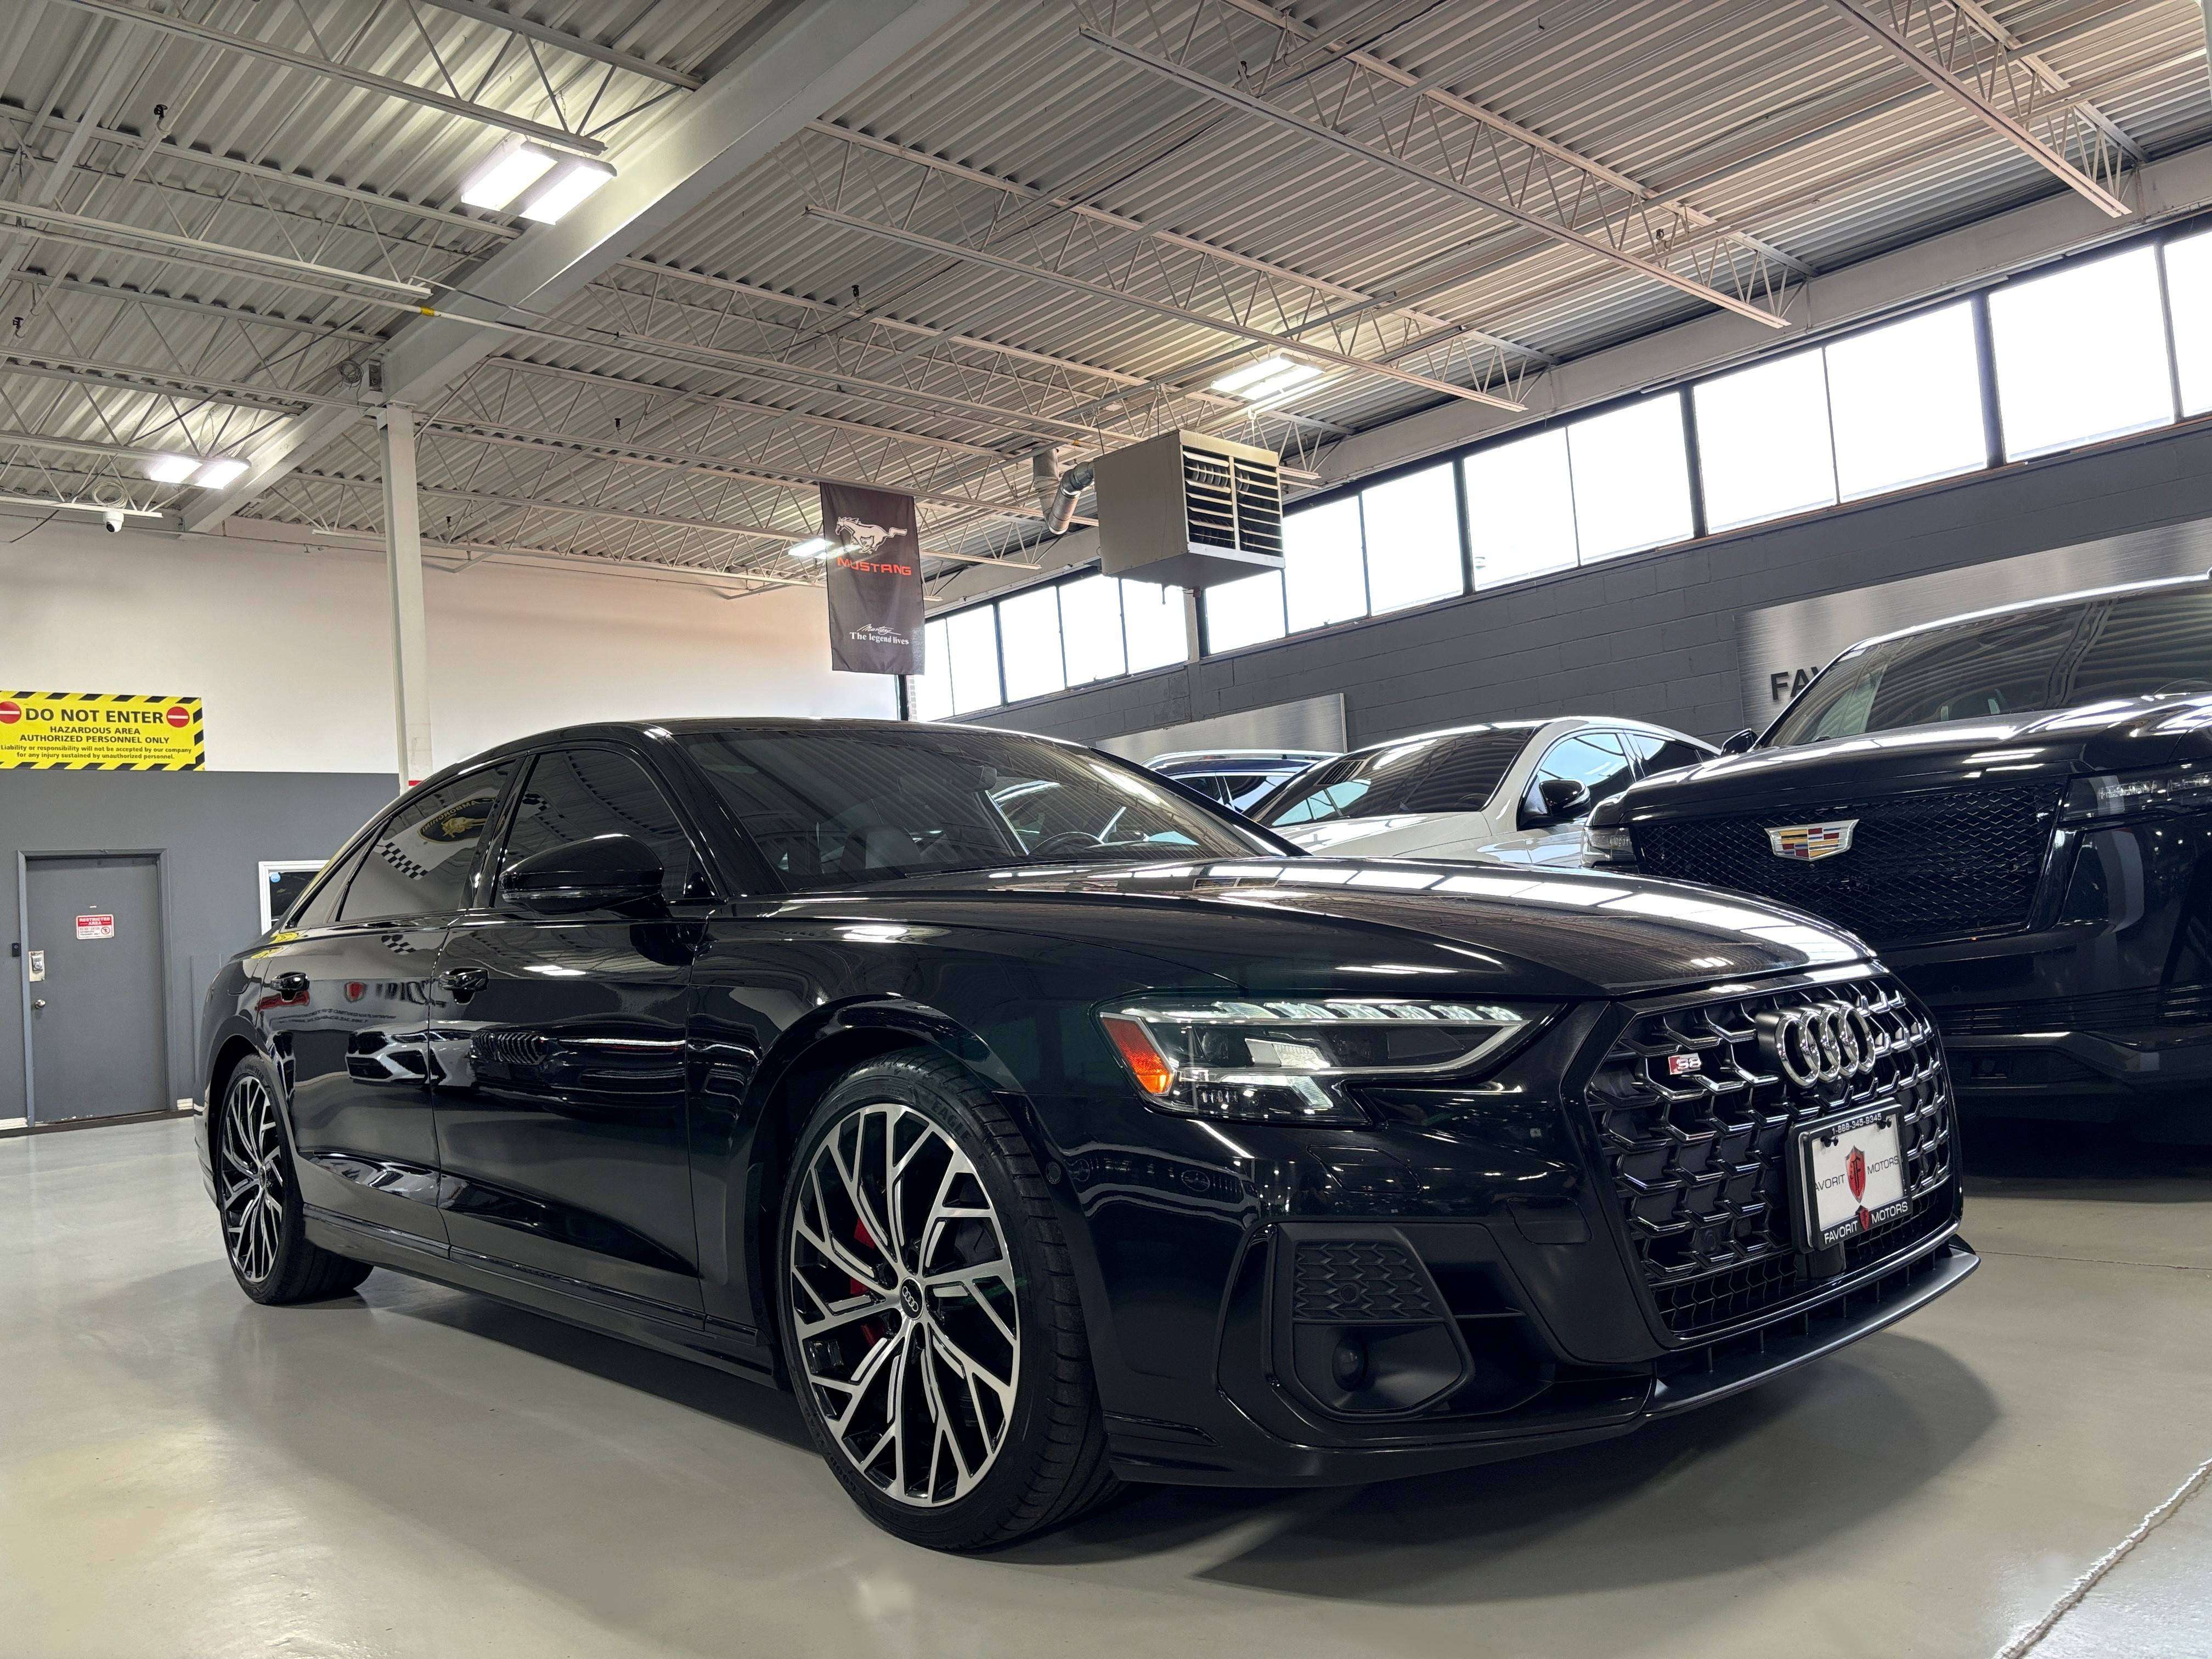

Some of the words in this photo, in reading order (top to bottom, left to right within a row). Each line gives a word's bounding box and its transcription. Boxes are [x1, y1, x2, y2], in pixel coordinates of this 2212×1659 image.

[837, 556, 912, 575] MUSTANG
[849, 631, 867, 640] The
[868, 633, 892, 644] legend
[893, 636, 910, 645] lives
[26, 708, 54, 721] DO
[61, 709, 100, 723] NOT
[106, 710, 164, 724] ENTER
[50, 726, 111, 734] HAZARDOUS
[20, 734, 83, 742] AUTHORIZED
[1676, 1057, 1702, 1071] S8
[1813, 1173, 1846, 1192] AVORIT
[1867, 1155, 1900, 1175] MOTORS
[1824, 1220, 1858, 1244] FAVORIT
[1871, 1201, 1909, 1224] MOTORS
